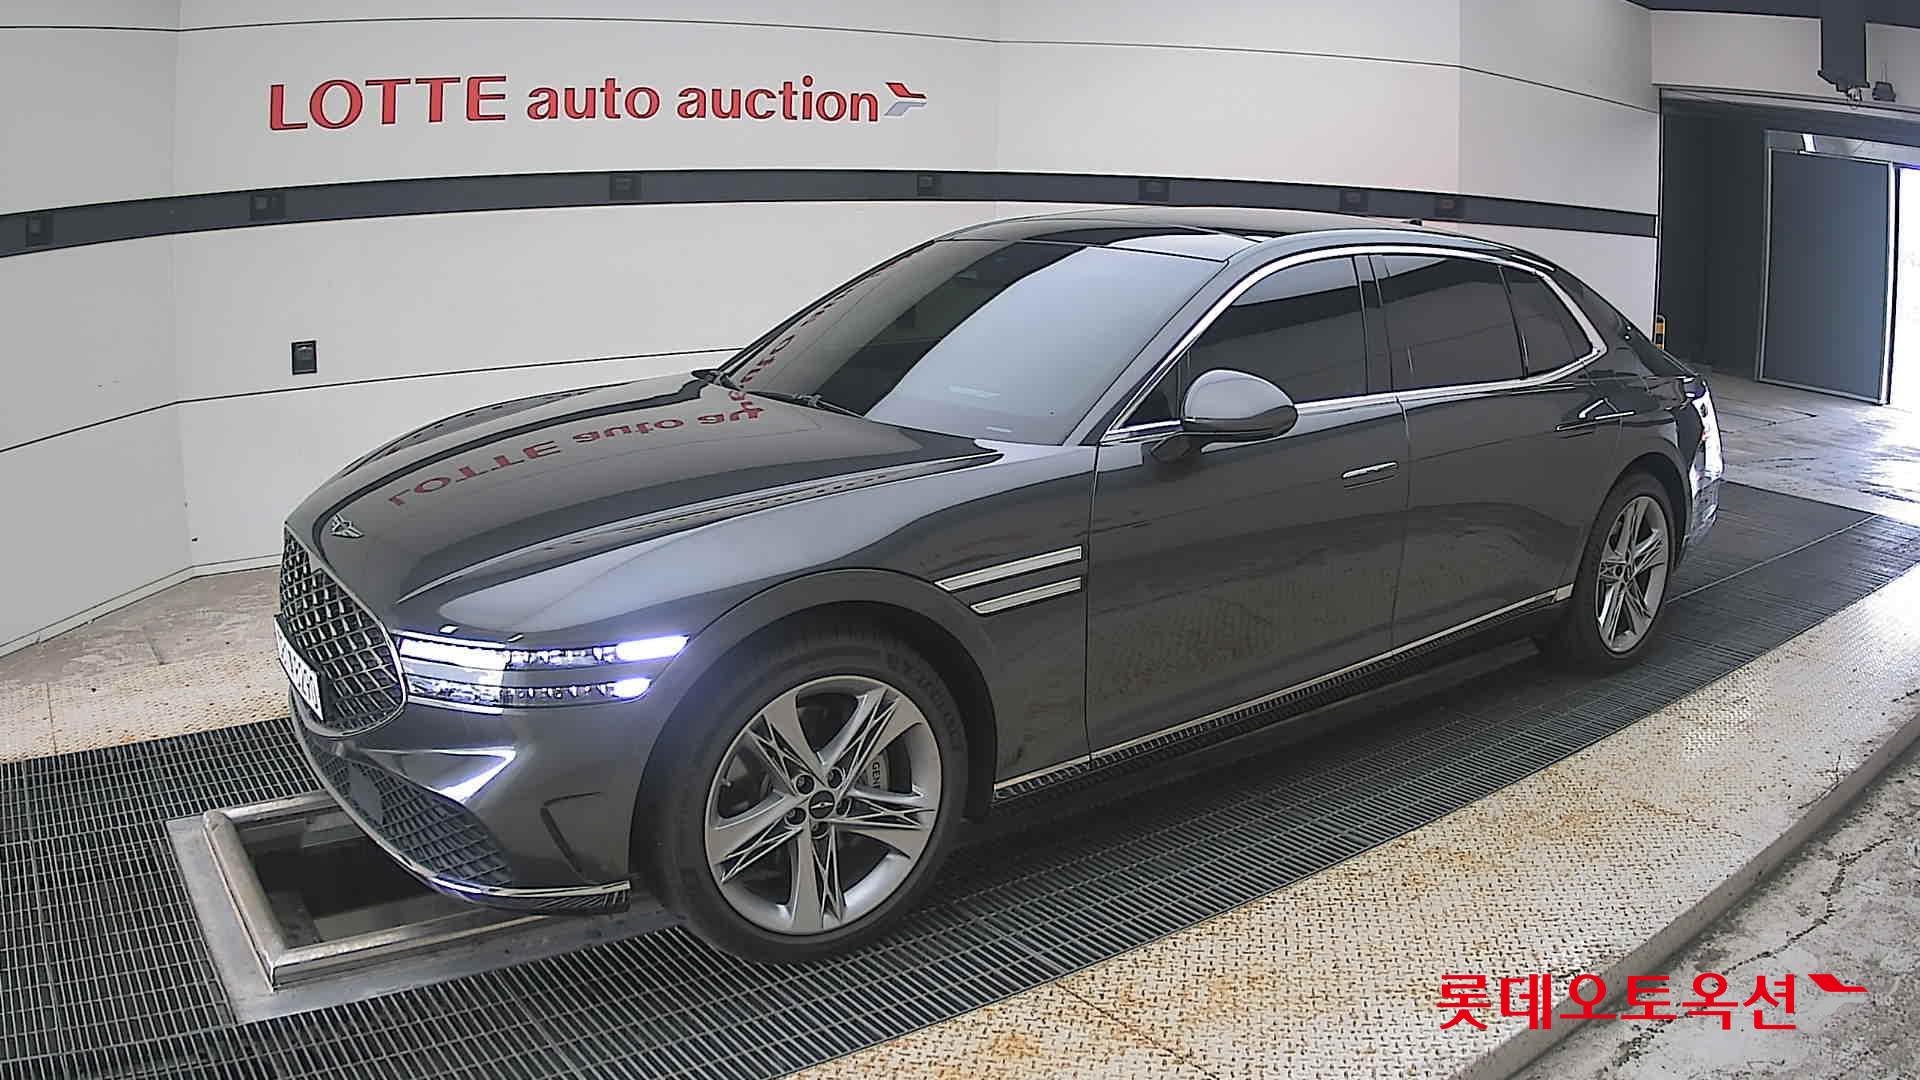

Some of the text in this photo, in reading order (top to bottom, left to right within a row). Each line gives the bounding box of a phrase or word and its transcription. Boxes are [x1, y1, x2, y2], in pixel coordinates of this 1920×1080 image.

[269, 75, 879, 131] LOTTE auto auction
